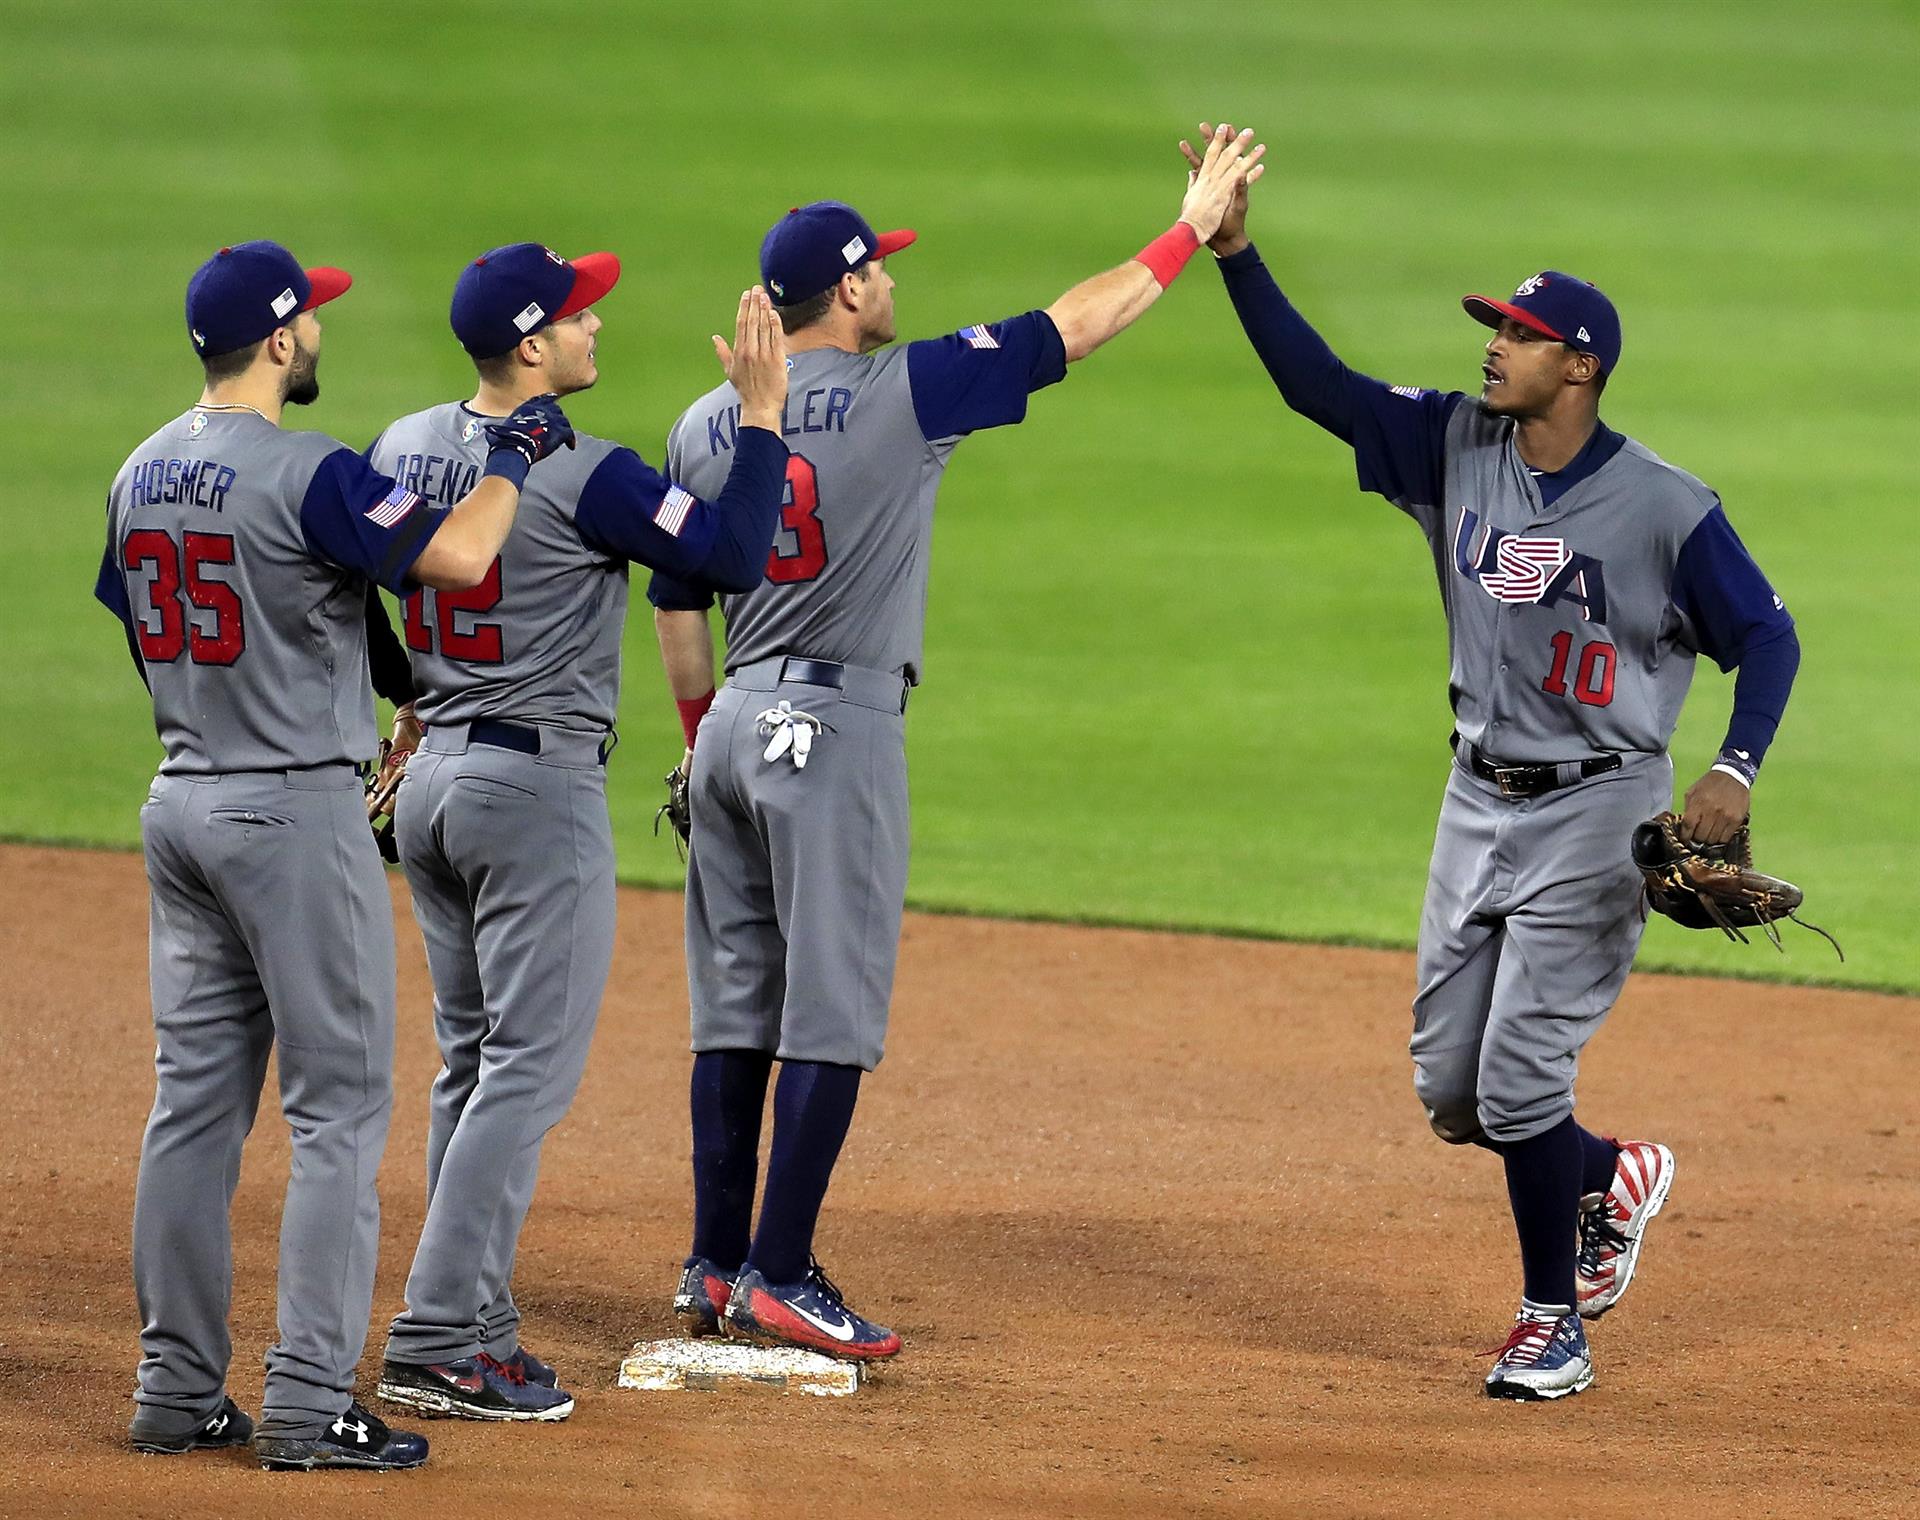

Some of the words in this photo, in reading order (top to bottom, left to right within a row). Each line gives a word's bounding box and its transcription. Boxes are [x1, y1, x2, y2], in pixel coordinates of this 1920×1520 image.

[707, 387, 852, 457] KILER
[131, 459, 237, 513] HOSMER
[123, 529, 246, 667] 35
[1453, 505, 1608, 626] USA
[1541, 629, 1618, 709] 10
